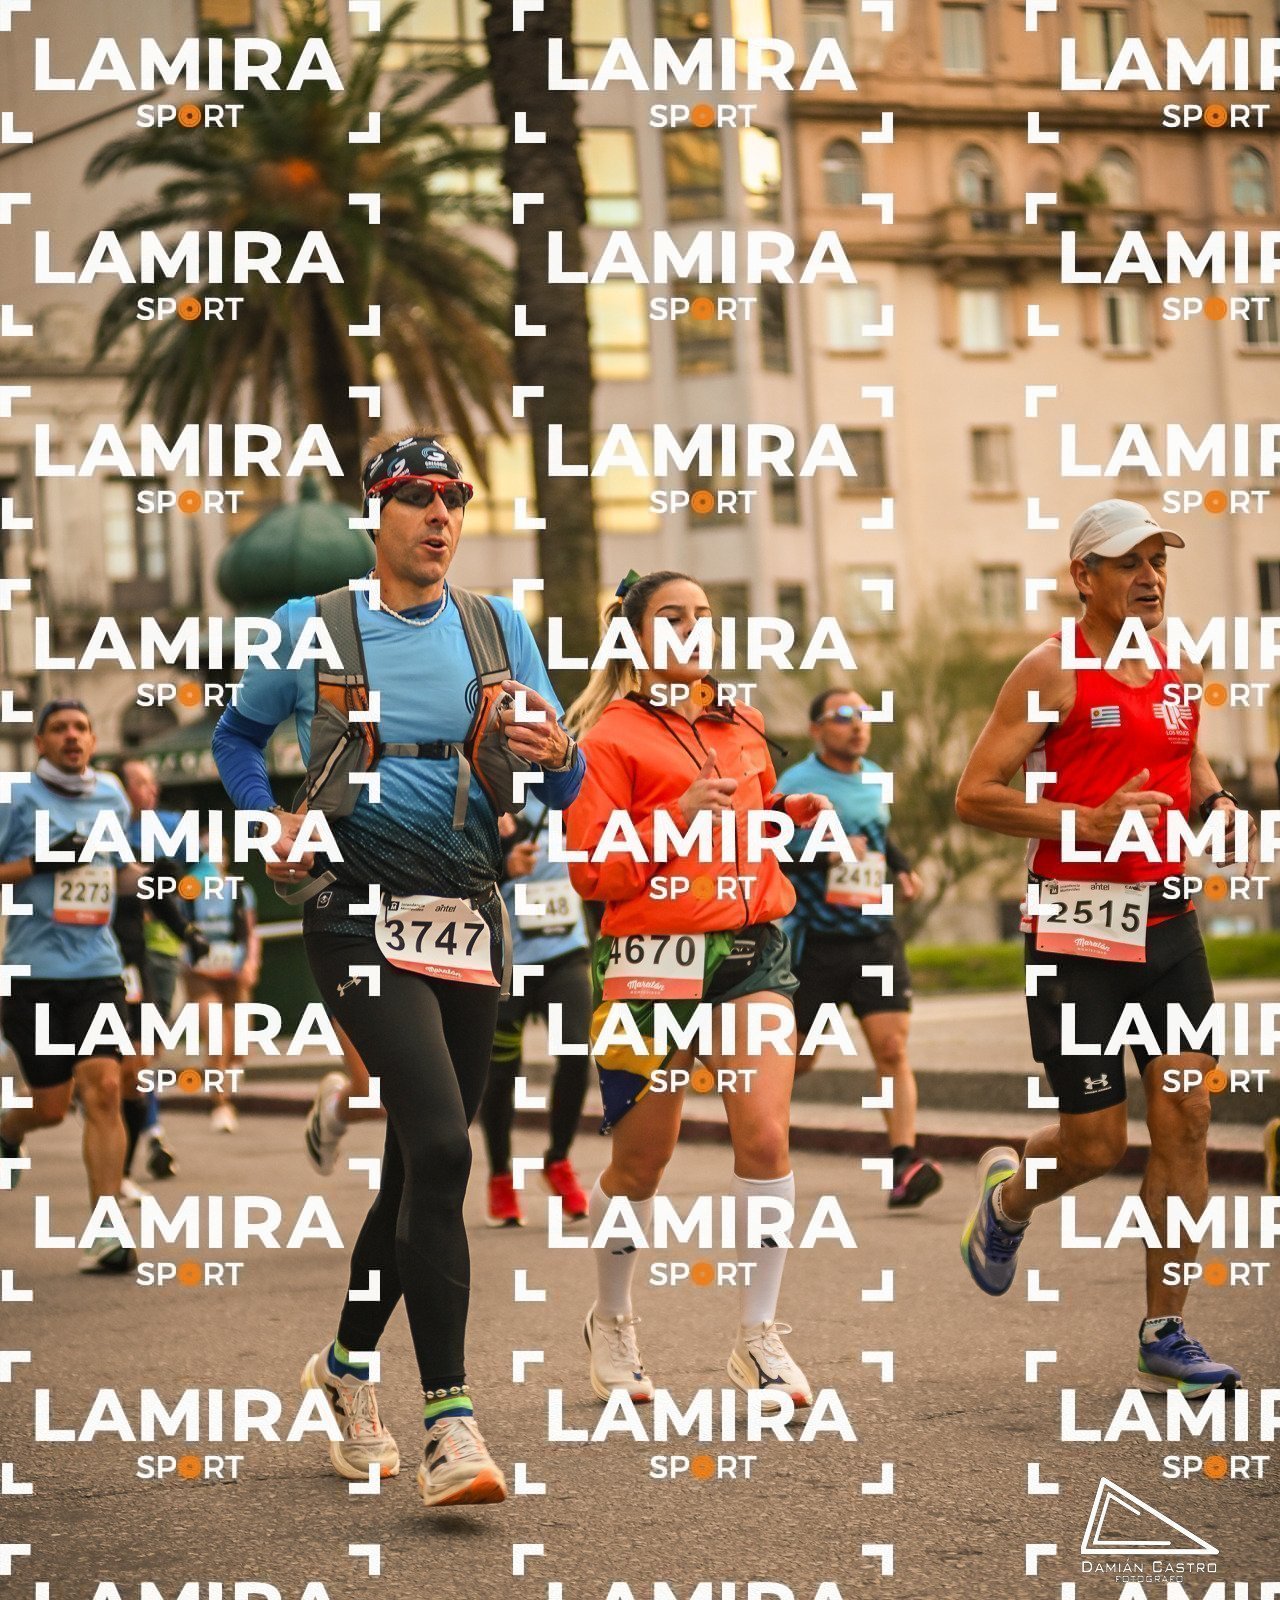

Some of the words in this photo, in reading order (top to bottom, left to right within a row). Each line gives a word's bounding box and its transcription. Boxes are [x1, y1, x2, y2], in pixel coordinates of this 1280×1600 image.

[60, 881, 110, 903] 2273
[1090, 882, 1110, 891] antel
[434, 904, 457, 913] antel
[1046, 899, 1141, 933] 2515
[384, 919, 485, 957] 3747
[609, 934, 697, 967] 4670
